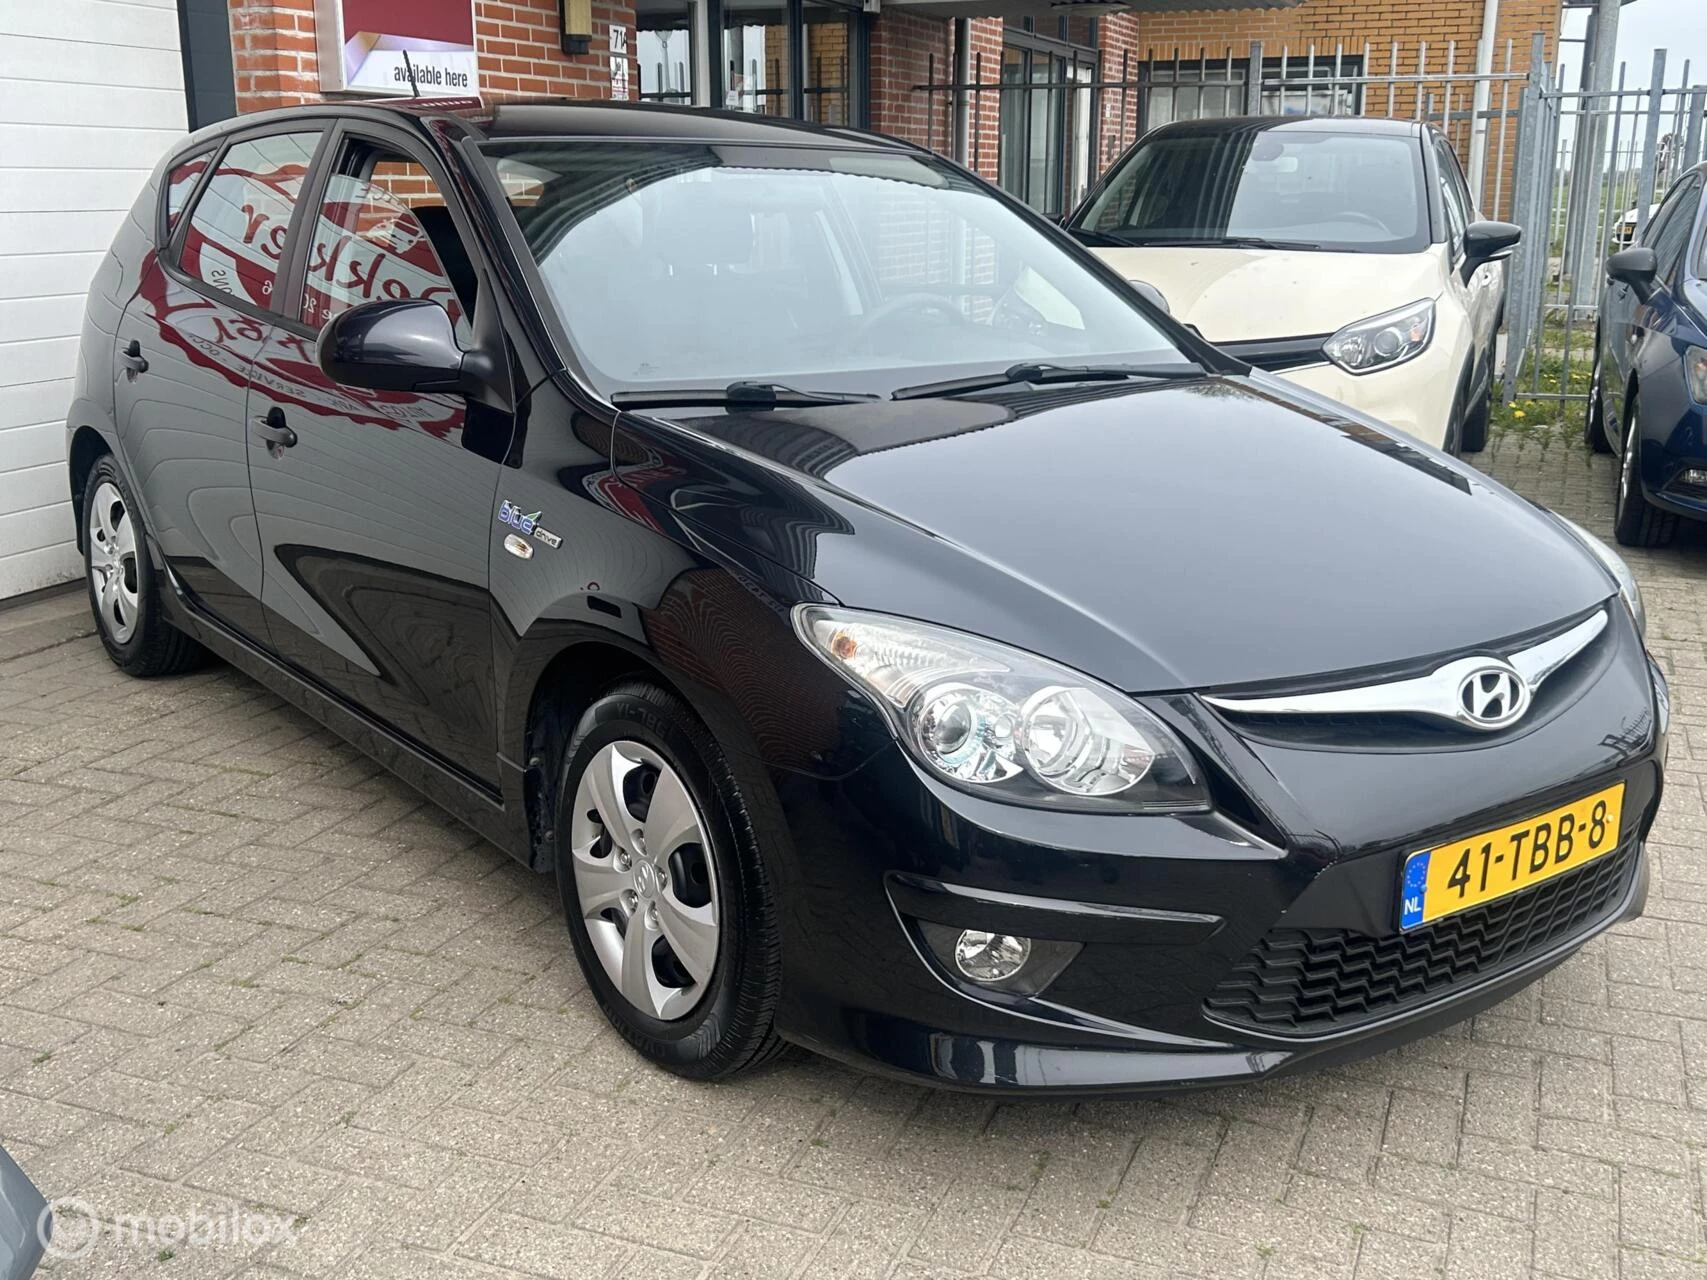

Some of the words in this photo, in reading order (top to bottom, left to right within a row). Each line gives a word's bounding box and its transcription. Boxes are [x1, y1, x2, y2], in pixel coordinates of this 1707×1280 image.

[394, 64, 442, 85] available
[445, 67, 468, 88] here
[498, 500, 536, 535] blue
[536, 529, 559, 547] drive
[1447, 799, 1606, 898] 41-TBB-8
[1404, 897, 1421, 915] NL
